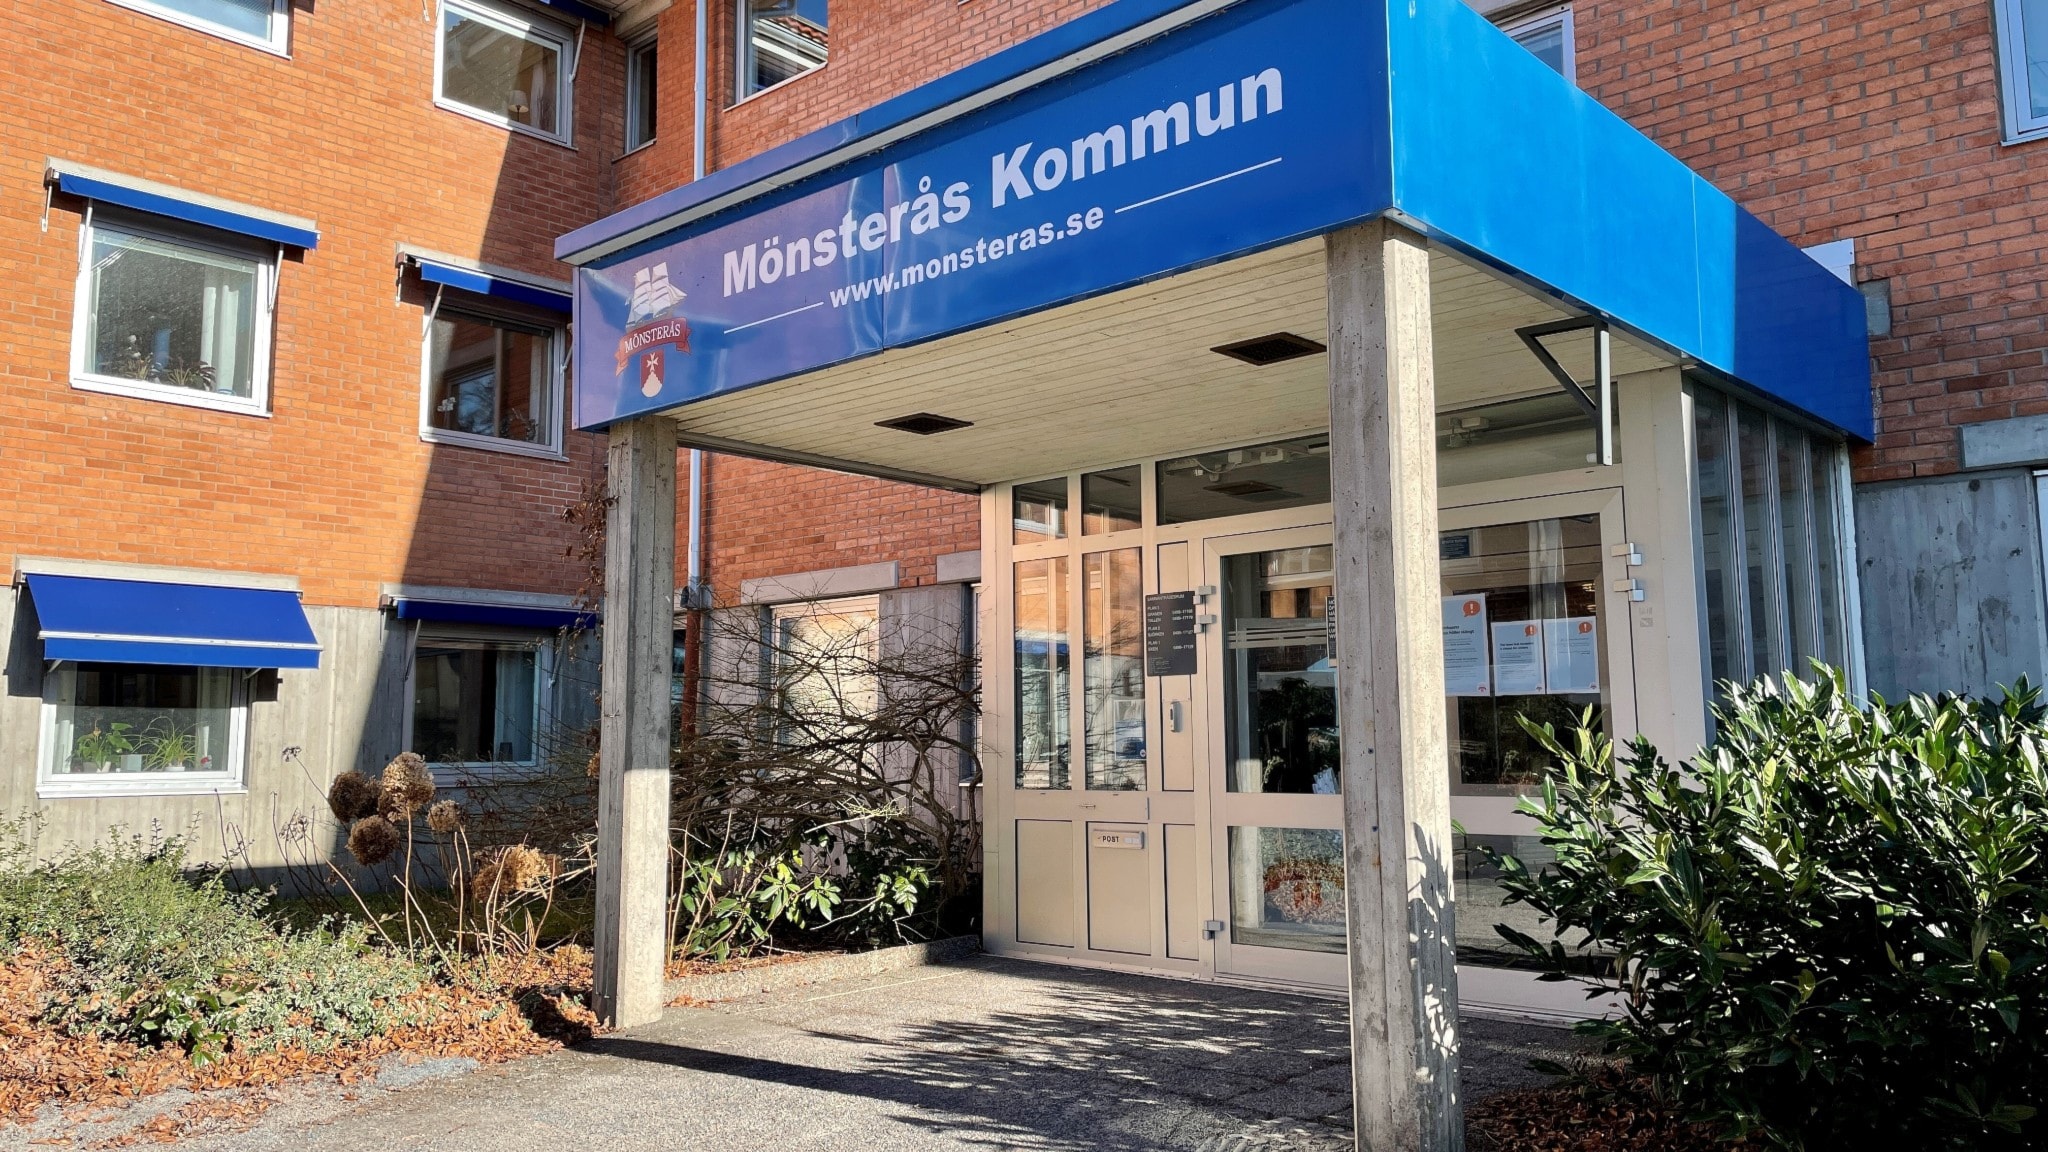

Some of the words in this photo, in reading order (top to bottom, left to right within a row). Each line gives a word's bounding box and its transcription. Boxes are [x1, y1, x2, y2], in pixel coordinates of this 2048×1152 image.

[723, 175, 971, 298] Mönsterås
[992, 67, 1283, 208] Kommun
[829, 206, 1104, 308] www.monsteras.se
[624, 321, 681, 354] MÖNSTERÅS
[1102, 835, 1120, 843] POST
